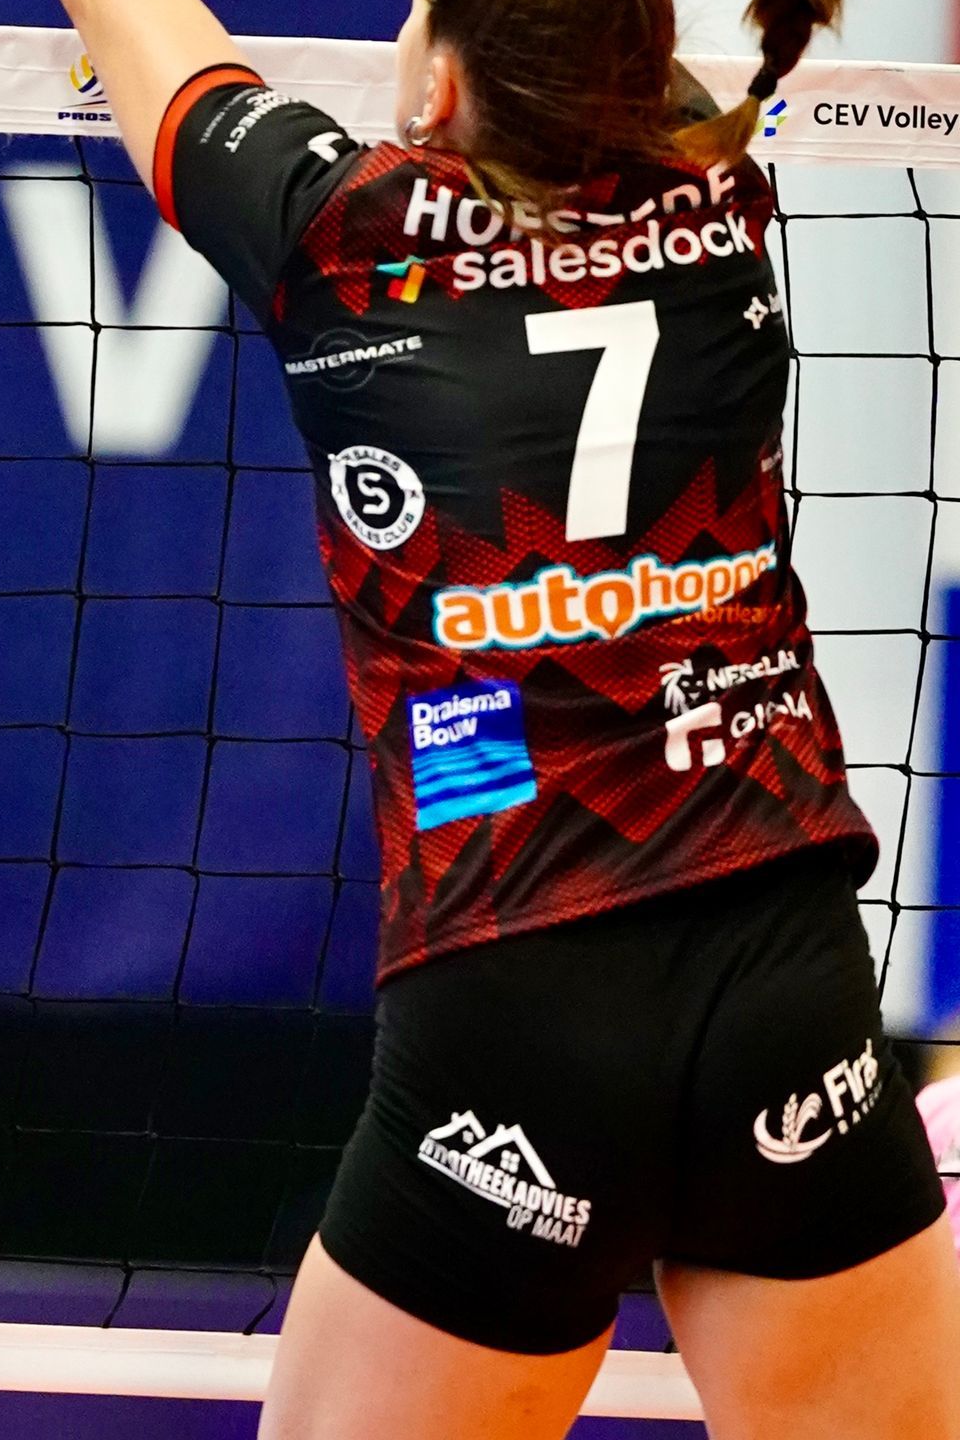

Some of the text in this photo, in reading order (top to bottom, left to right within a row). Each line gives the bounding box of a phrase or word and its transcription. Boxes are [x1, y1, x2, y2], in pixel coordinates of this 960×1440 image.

[58, 112, 112, 122] PROS
[813, 102, 959, 136] CEV Volley
[452, 210, 755, 291] salesdock
[285, 335, 424, 375] MASTERMATE
[524, 299, 660, 542] 7
[412, 689, 511, 725] Draisma
[413, 716, 478, 750] Bouw
[506, 1204, 587, 1249] OP MAAT
